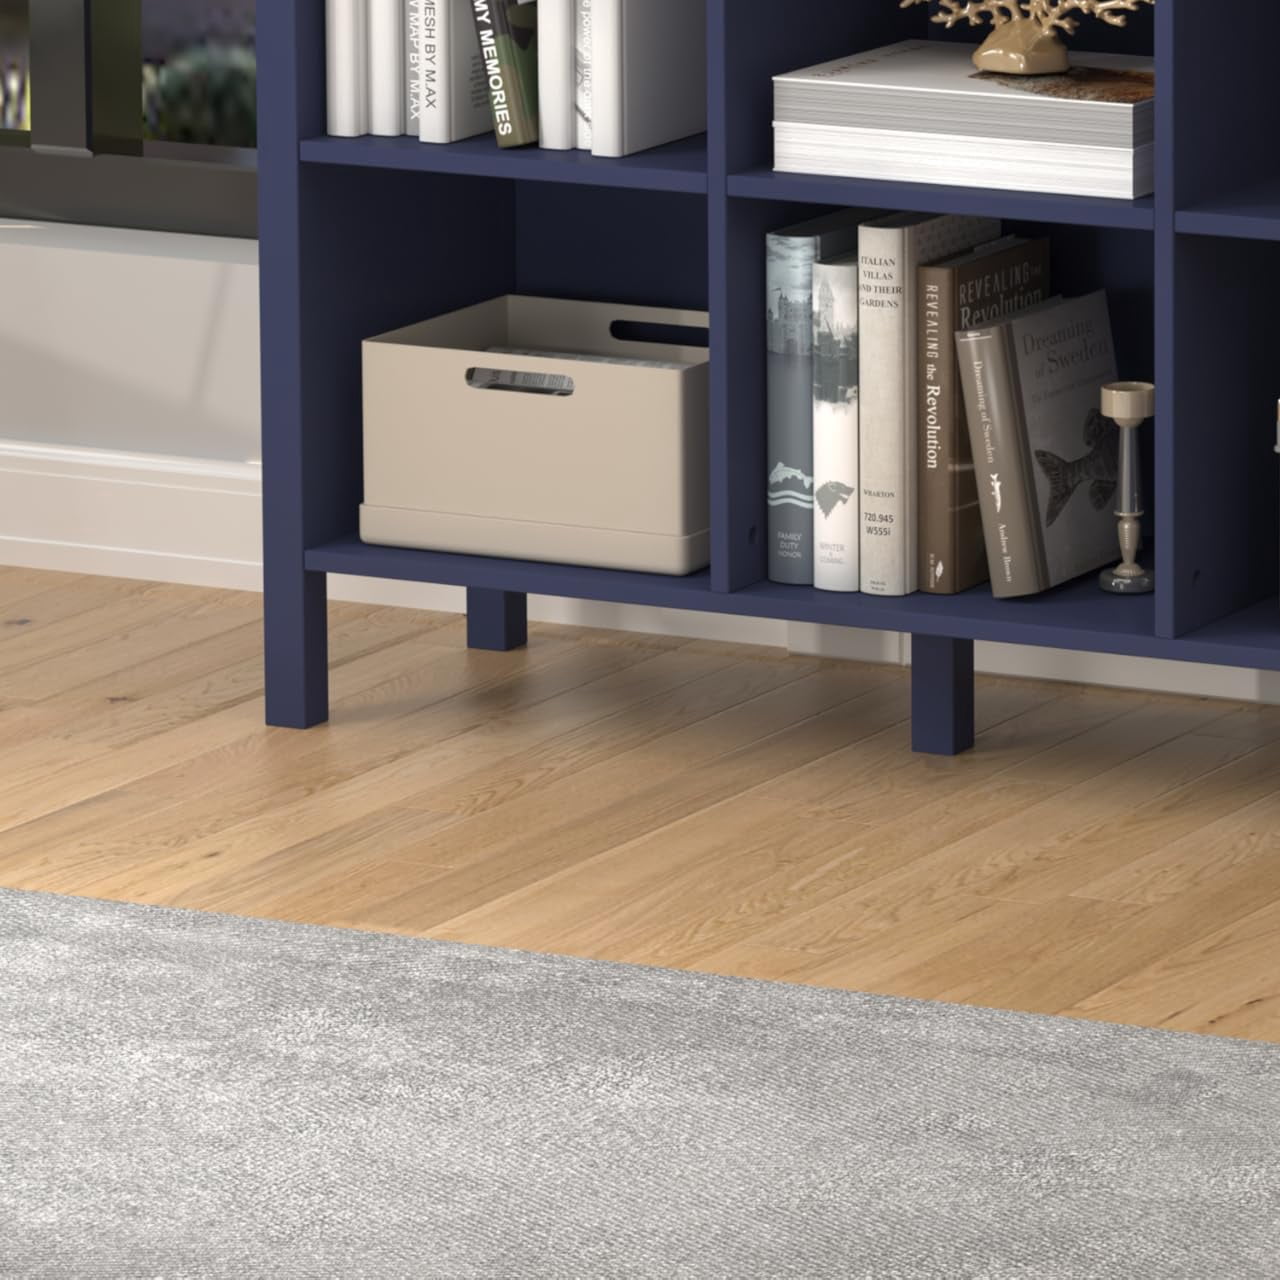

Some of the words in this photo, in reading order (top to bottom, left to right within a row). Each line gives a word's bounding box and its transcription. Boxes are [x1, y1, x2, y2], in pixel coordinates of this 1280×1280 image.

[409, 11, 420, 49] MAP
[410, 52, 420, 74] BY
[425, 43, 437, 65] BY
[425, 69, 437, 109] M.AX
[479, 26, 513, 136] MEMORIES
[860, 255, 896, 268] ITALIAN
[862, 270, 894, 281] VILLAS
[873, 284, 903, 296] THEIR
[925, 283, 939, 358] REVEALING
[926, 363, 936, 380] the
[973, 360, 990, 411] Dreaming
[982, 424, 995, 464] Sweden
[926, 385, 941, 469] Revolution
[863, 512, 895, 525] 720.945
